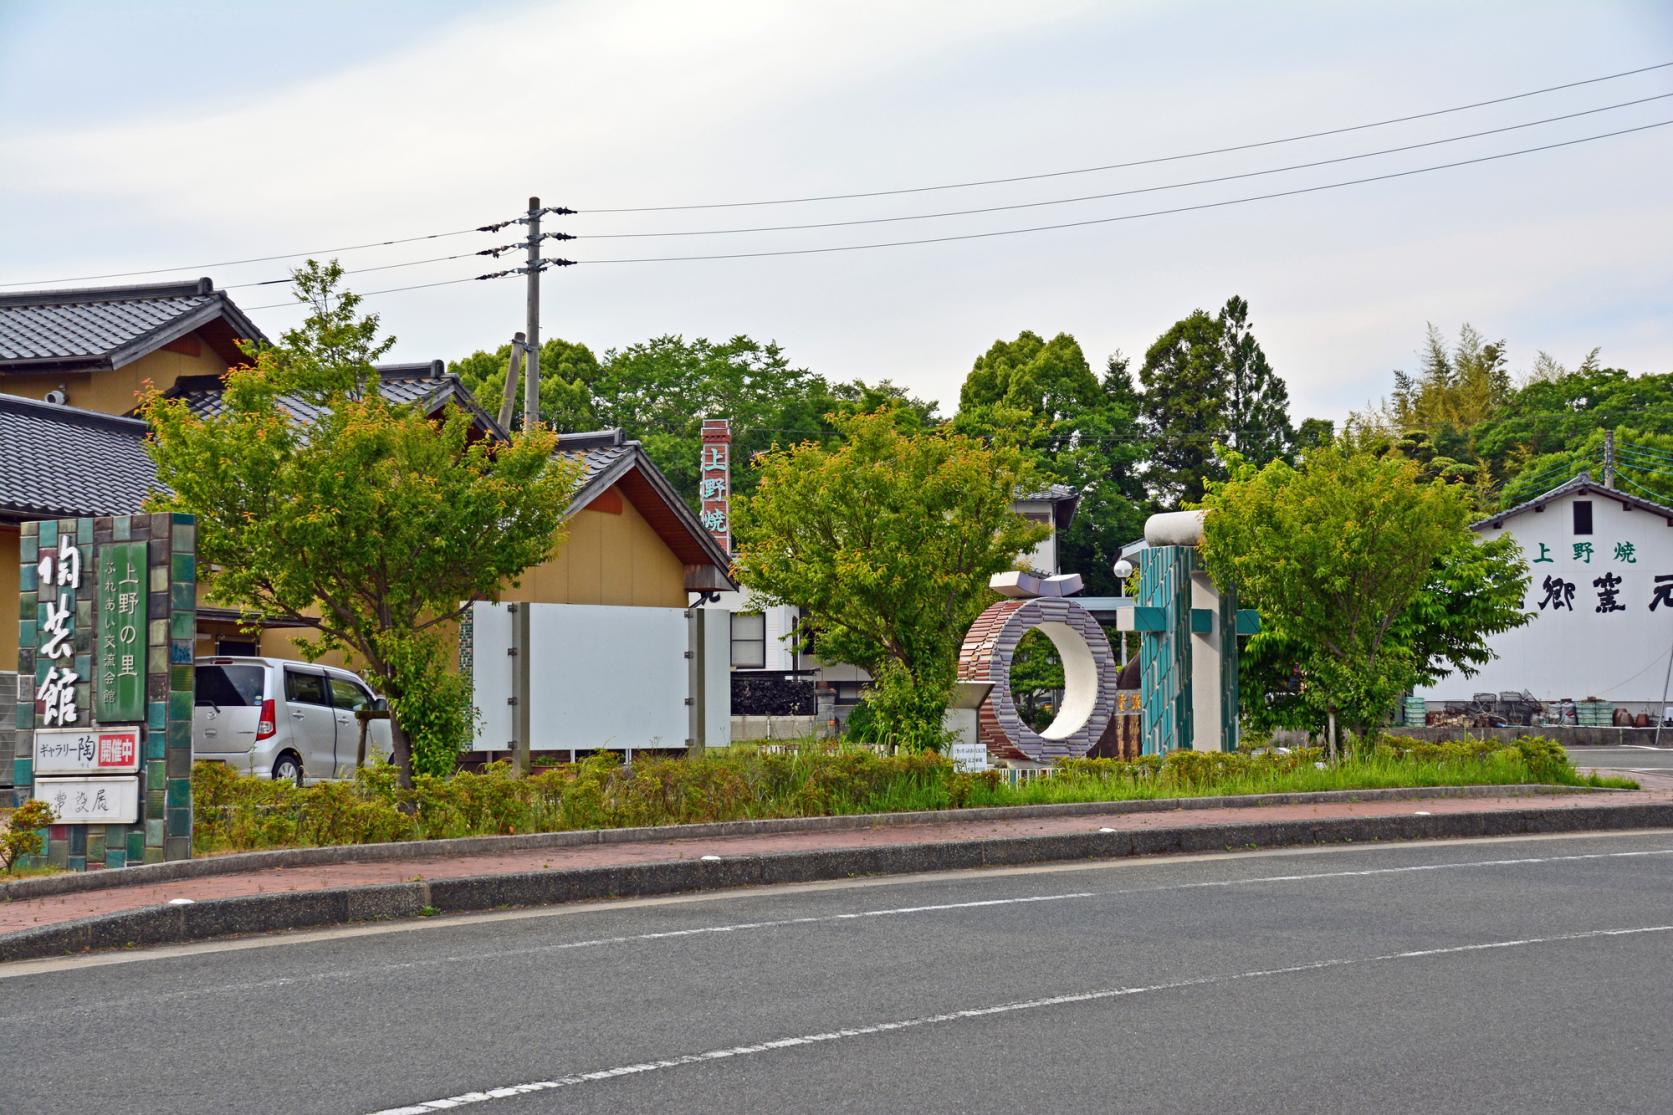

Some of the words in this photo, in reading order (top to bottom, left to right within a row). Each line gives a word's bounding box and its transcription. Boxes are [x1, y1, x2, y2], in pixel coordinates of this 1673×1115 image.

[704, 448, 728, 532] 上野焼
[1533, 541, 1637, 563] 上野焼
[37, 535, 80, 726] 陶芸館
[103, 562, 116, 704] ふれあい交流会館
[118, 562, 139, 677] 上野の里
[40, 735, 96, 761] ギャラリー陶
[100, 739, 133, 763] 開催中
[54, 788, 109, 814] 常設展
